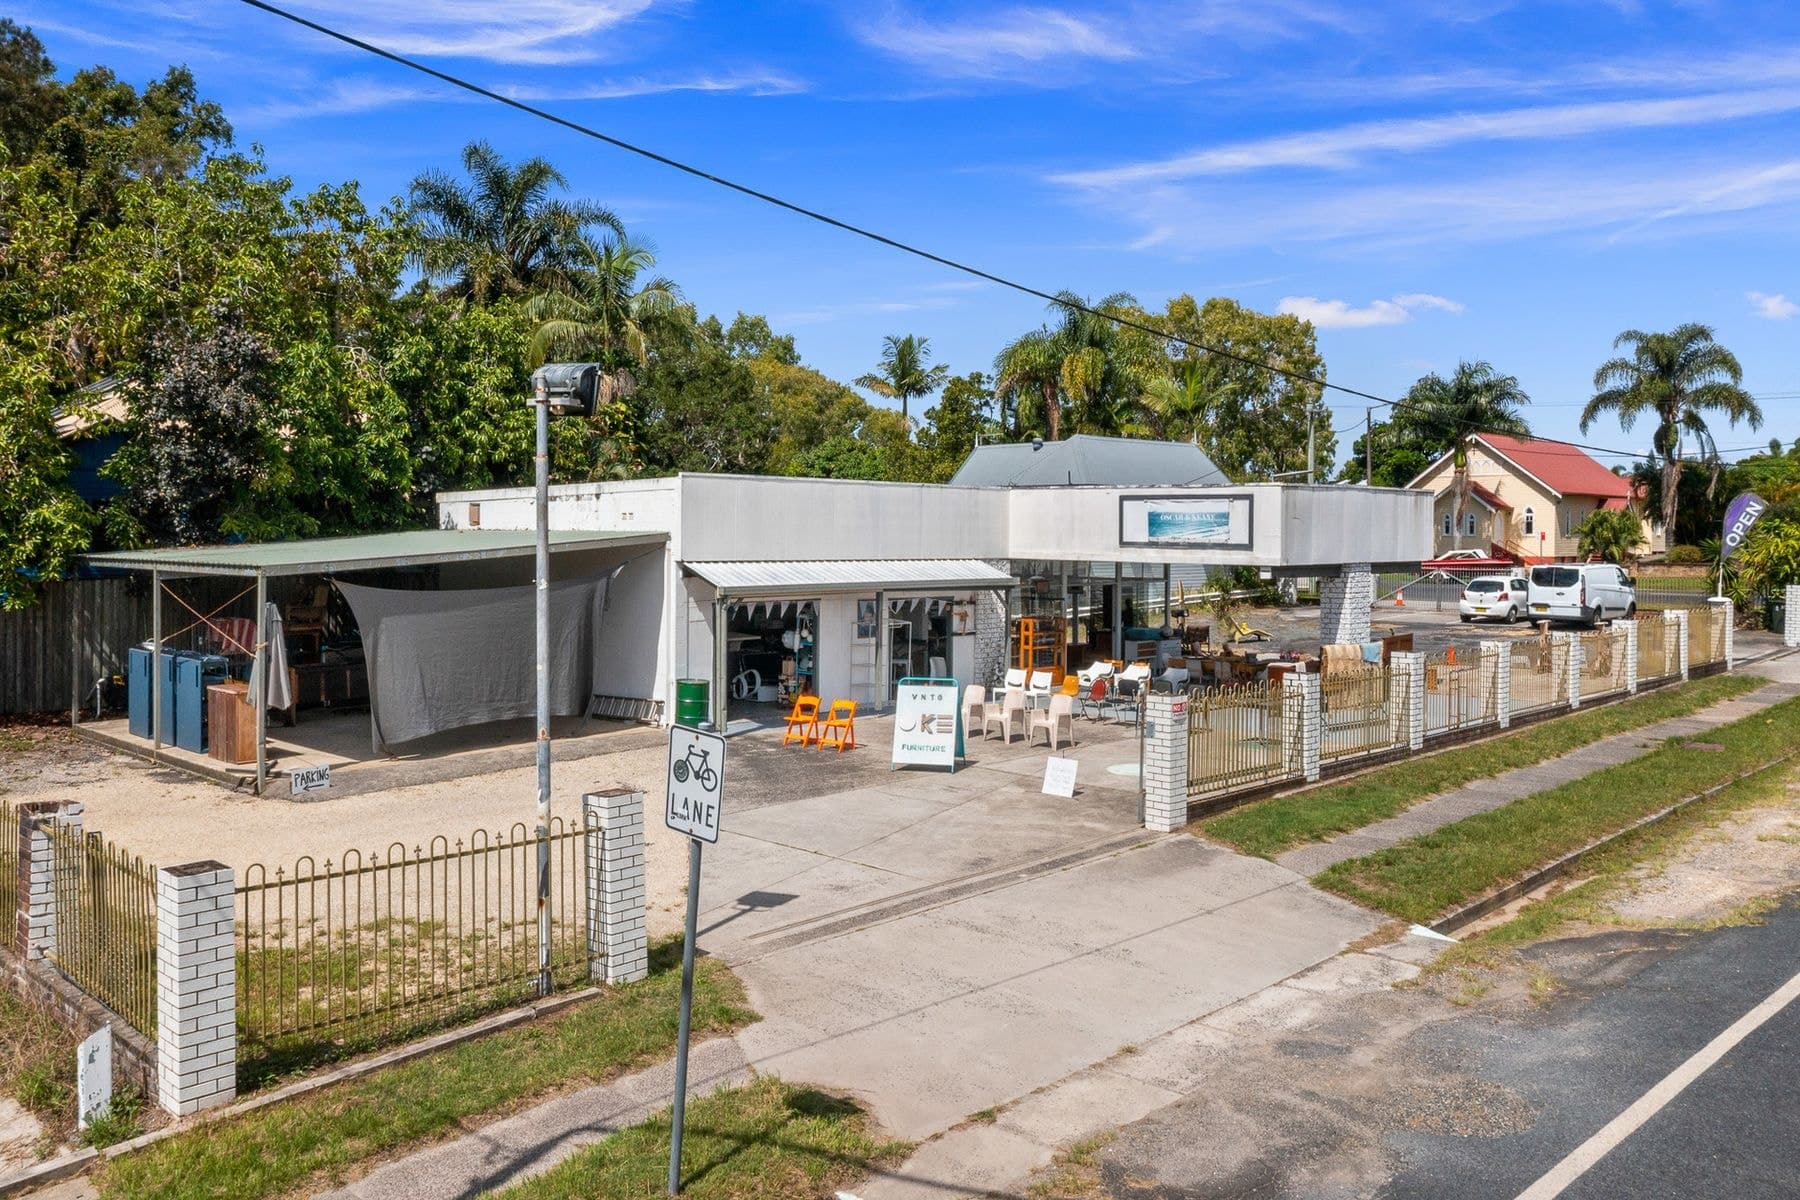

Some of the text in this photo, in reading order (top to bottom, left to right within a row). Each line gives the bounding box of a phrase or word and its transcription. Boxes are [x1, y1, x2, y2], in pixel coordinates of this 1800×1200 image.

[1726, 501, 1763, 546] OPEN
[901, 743, 946, 752] FURNITURE
[294, 767, 330, 788] PARKING
[671, 793, 715, 828] LANE
